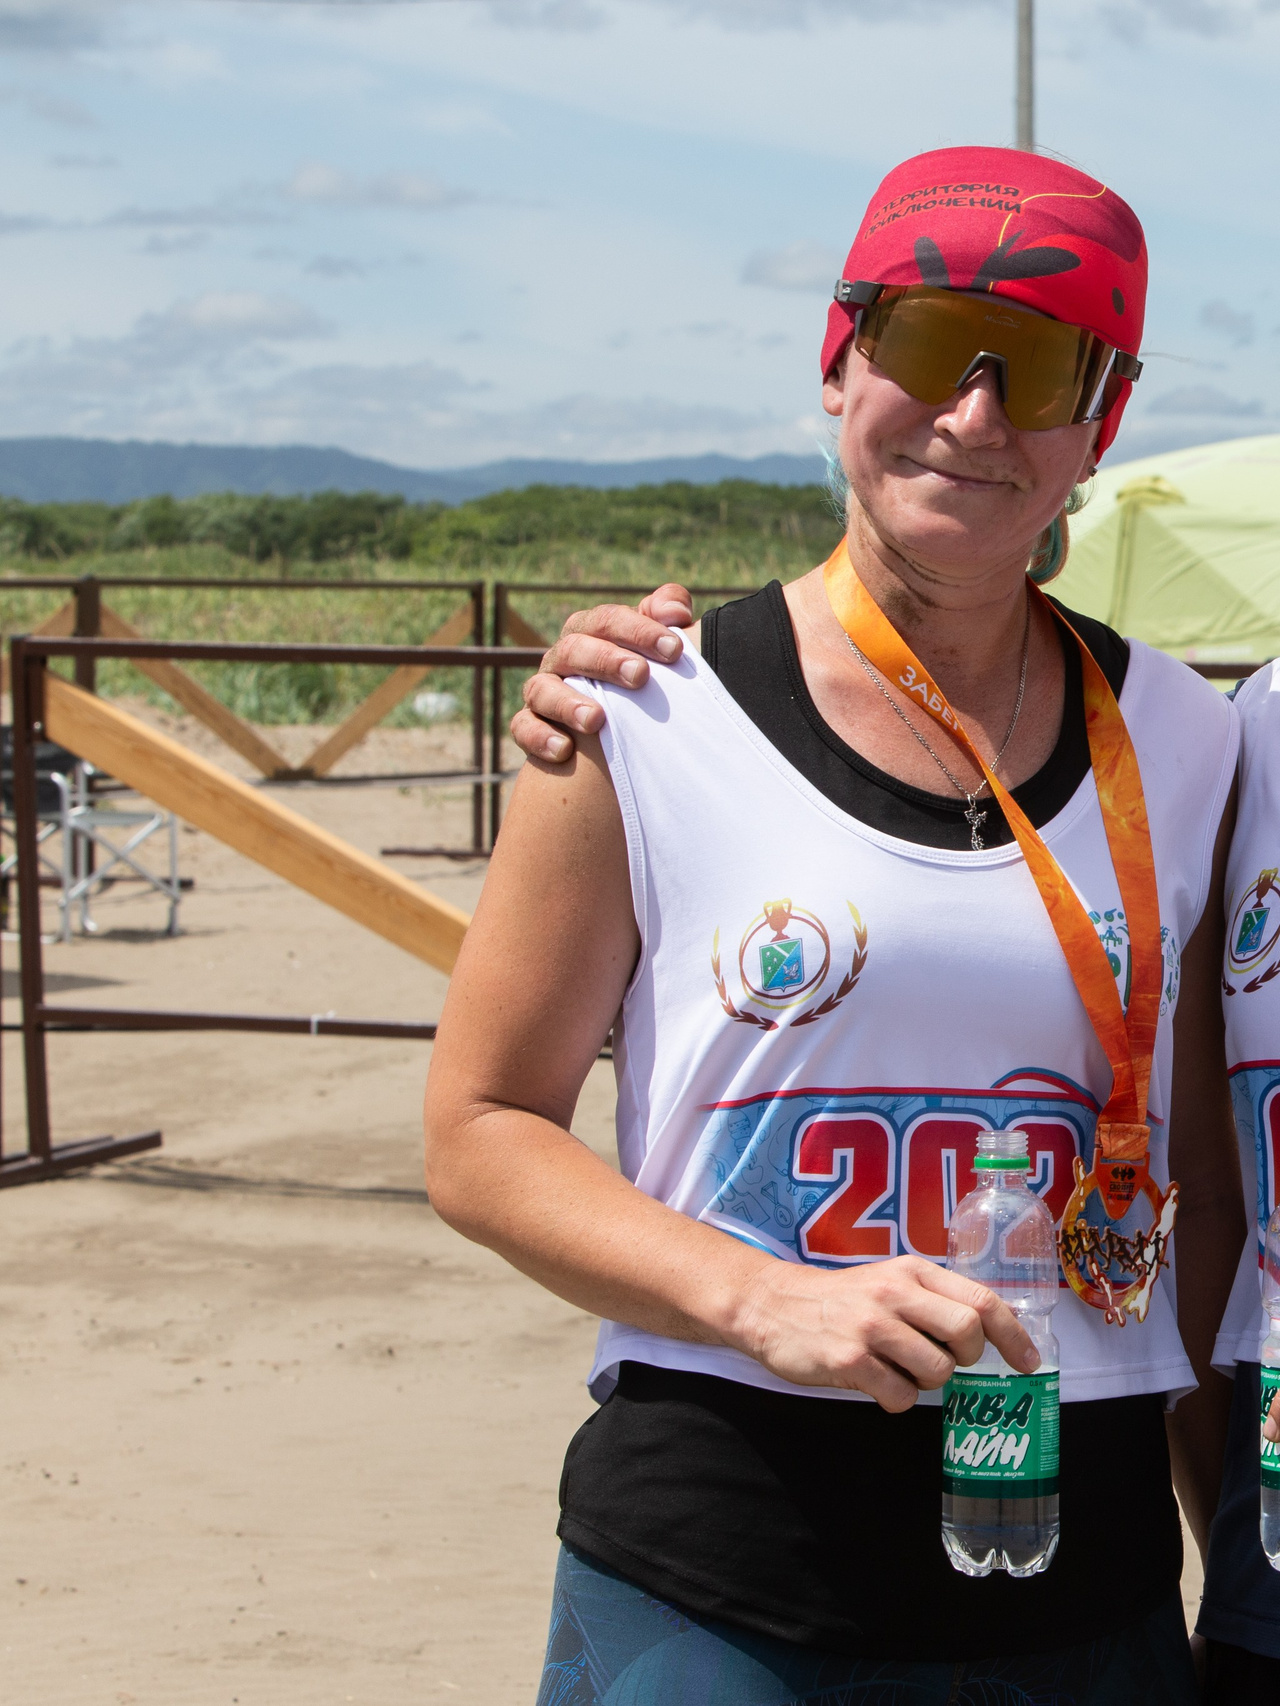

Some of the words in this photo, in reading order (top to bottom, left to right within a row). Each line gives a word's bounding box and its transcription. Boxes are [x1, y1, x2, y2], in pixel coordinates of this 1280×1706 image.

[883, 183, 1020, 214] ТЕРРИТОРИЯ
[791, 1109, 1085, 1263] 202
[952, 1378, 1011, 1388] НЕГАЗИРОВАННАЯ
[943, 1389, 1034, 1430] АКВА
[943, 1426, 1031, 1471] ЛАЙН
